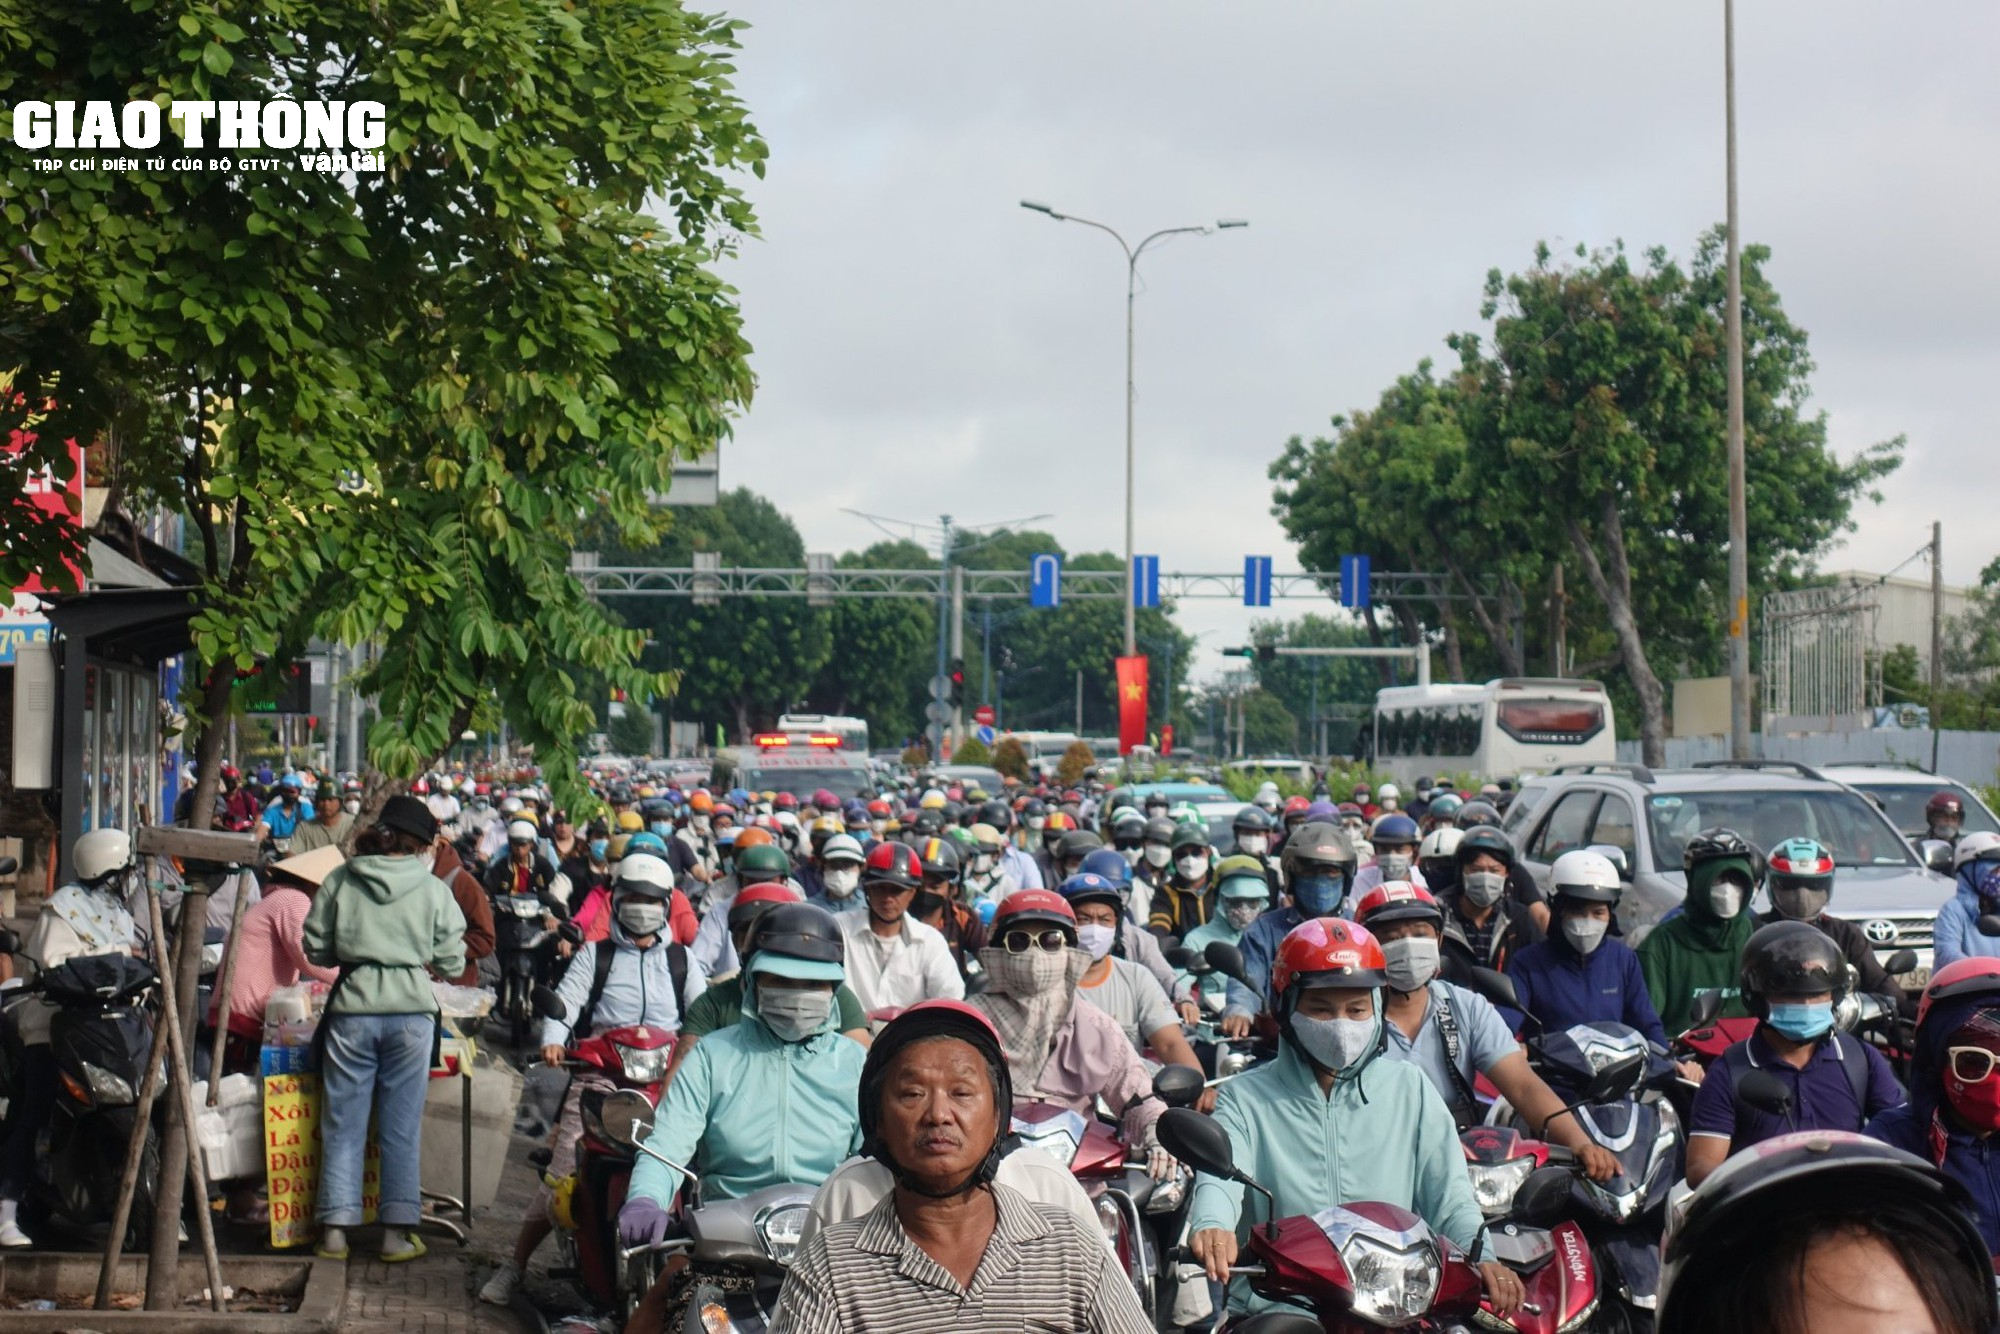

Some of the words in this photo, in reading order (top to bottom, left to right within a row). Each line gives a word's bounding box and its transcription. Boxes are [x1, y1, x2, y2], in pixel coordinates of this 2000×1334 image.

[268, 1103, 311, 1122] Xôi
[270, 1151, 316, 1173] Đậu
[271, 1175, 317, 1197] Đậu
[272, 1201, 316, 1224] Đậu
[1562, 1230, 1587, 1281] MONSTER
